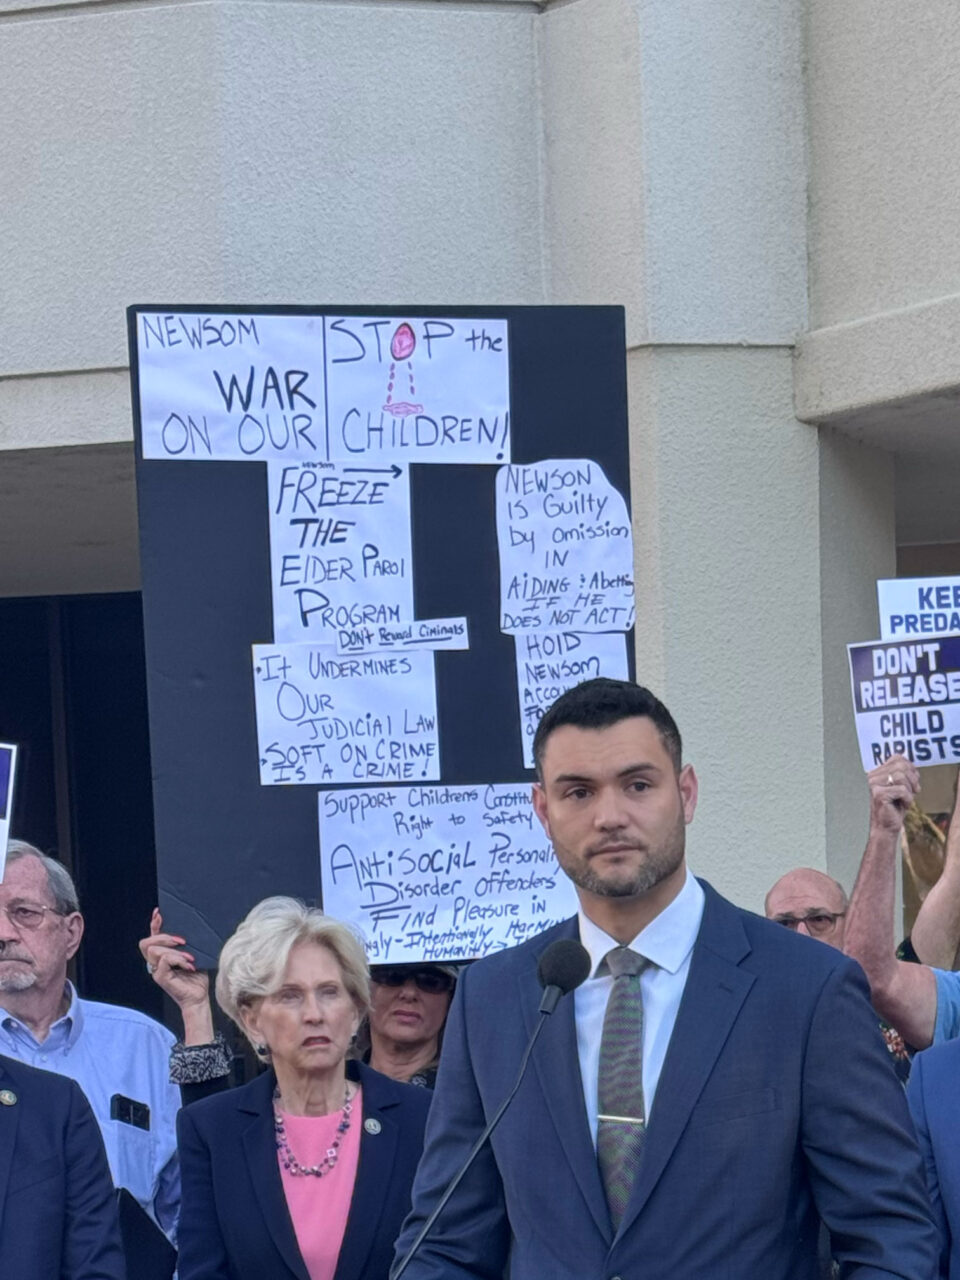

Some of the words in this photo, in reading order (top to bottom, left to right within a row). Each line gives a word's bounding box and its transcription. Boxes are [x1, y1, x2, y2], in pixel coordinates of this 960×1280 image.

[142, 315, 260, 349] NEWSOM
[330, 319, 454, 363] STOP
[465, 328, 503, 352] the
[213, 365, 317, 413] WAR
[162, 412, 212, 455] ON
[238, 413, 317, 455] OUR
[342, 407, 509, 460] CHILDREN!
[275, 466, 389, 514] FREEZE
[543, 490, 608, 521] Guilty
[290, 518, 356, 548] THE
[293, 588, 400, 628] PROGRAM
[574, 592, 606, 607] HE
[503, 612, 542, 630] DOES
[550, 609, 581, 625] NOT
[309, 651, 412, 680] UNDERMINES
[873, 643, 940, 677] DON'T
[277, 682, 334, 721] OUR
[404, 709, 435, 734] LAW
[880, 710, 945, 738] CHILD
[265, 742, 325, 766] SOFT
[341, 743, 367, 764] ON
[376, 738, 436, 762] CRIME
[322, 763, 334, 779] A
[449, 813, 466, 825] to
